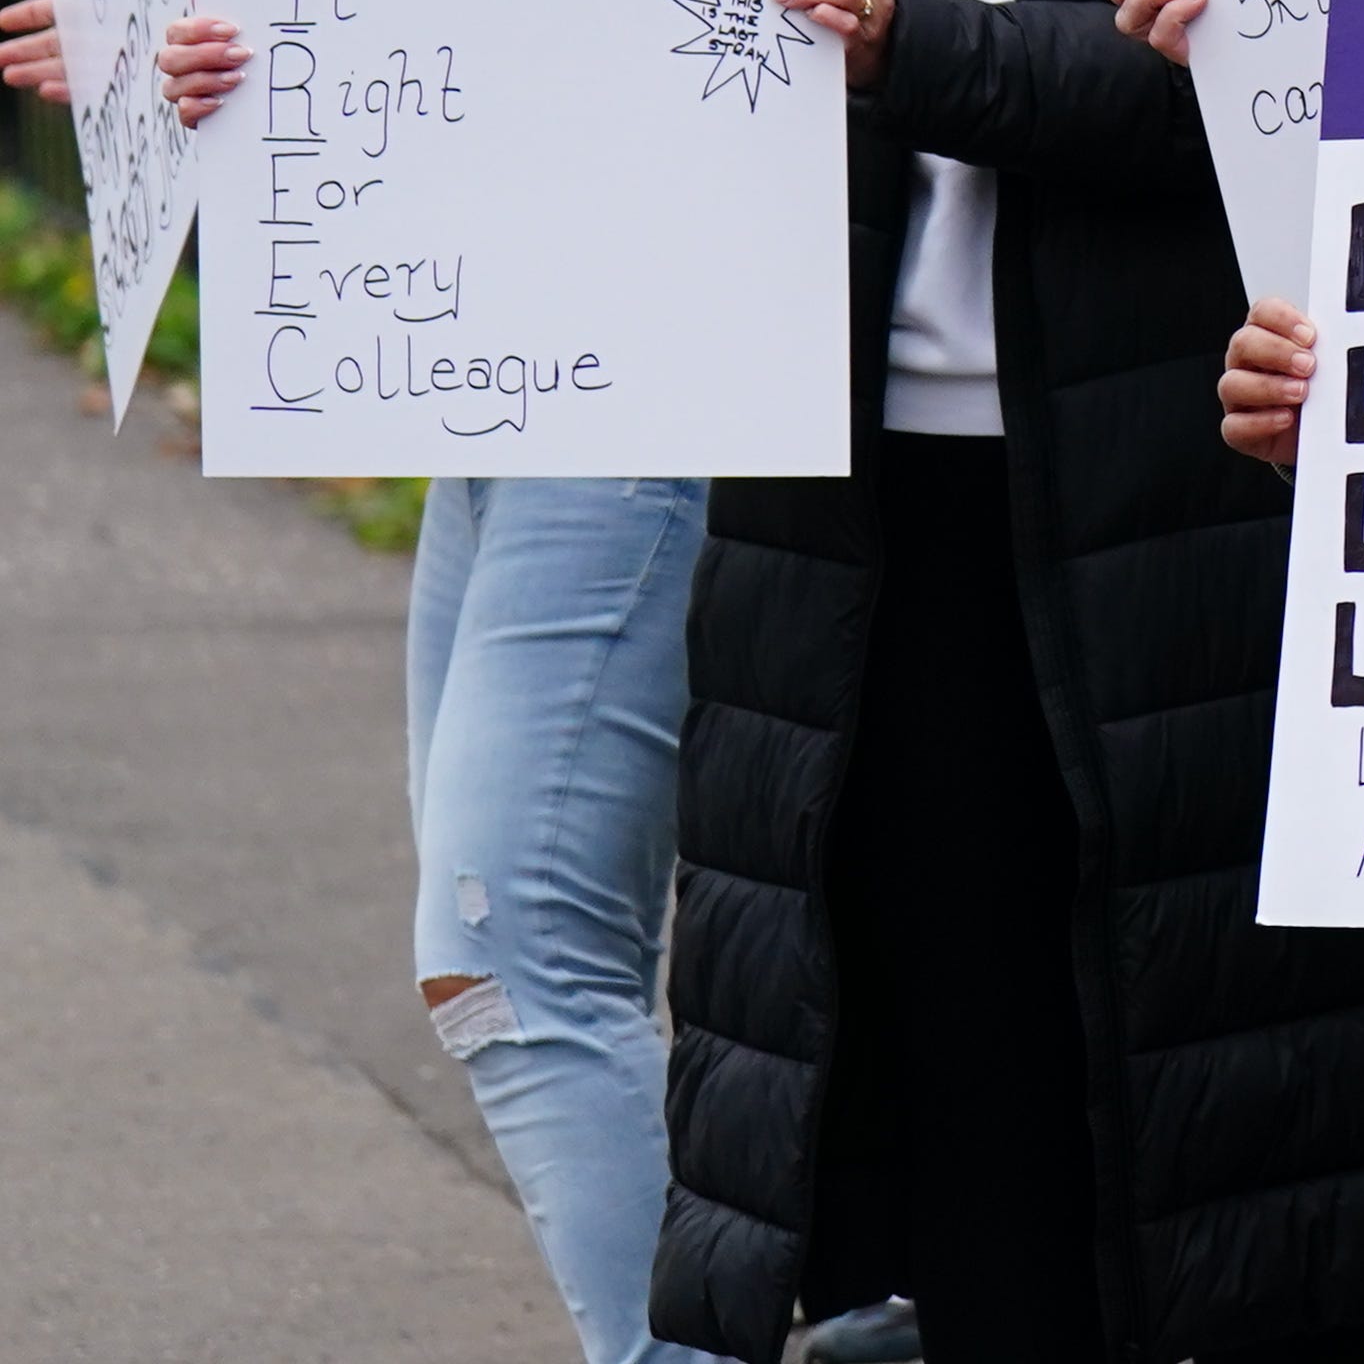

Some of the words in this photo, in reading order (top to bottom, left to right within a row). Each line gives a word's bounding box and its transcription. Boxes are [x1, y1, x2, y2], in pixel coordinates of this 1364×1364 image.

[701, 7, 718, 18] IS
[723, 12, 760, 28] THE
[707, 38, 771, 64] STRAW
[717, 24, 760, 43] LAST
[268, 40, 466, 158] Right
[264, 151, 385, 222] For
[262, 239, 463, 323] Every
[258, 325, 613, 436] Colleague
